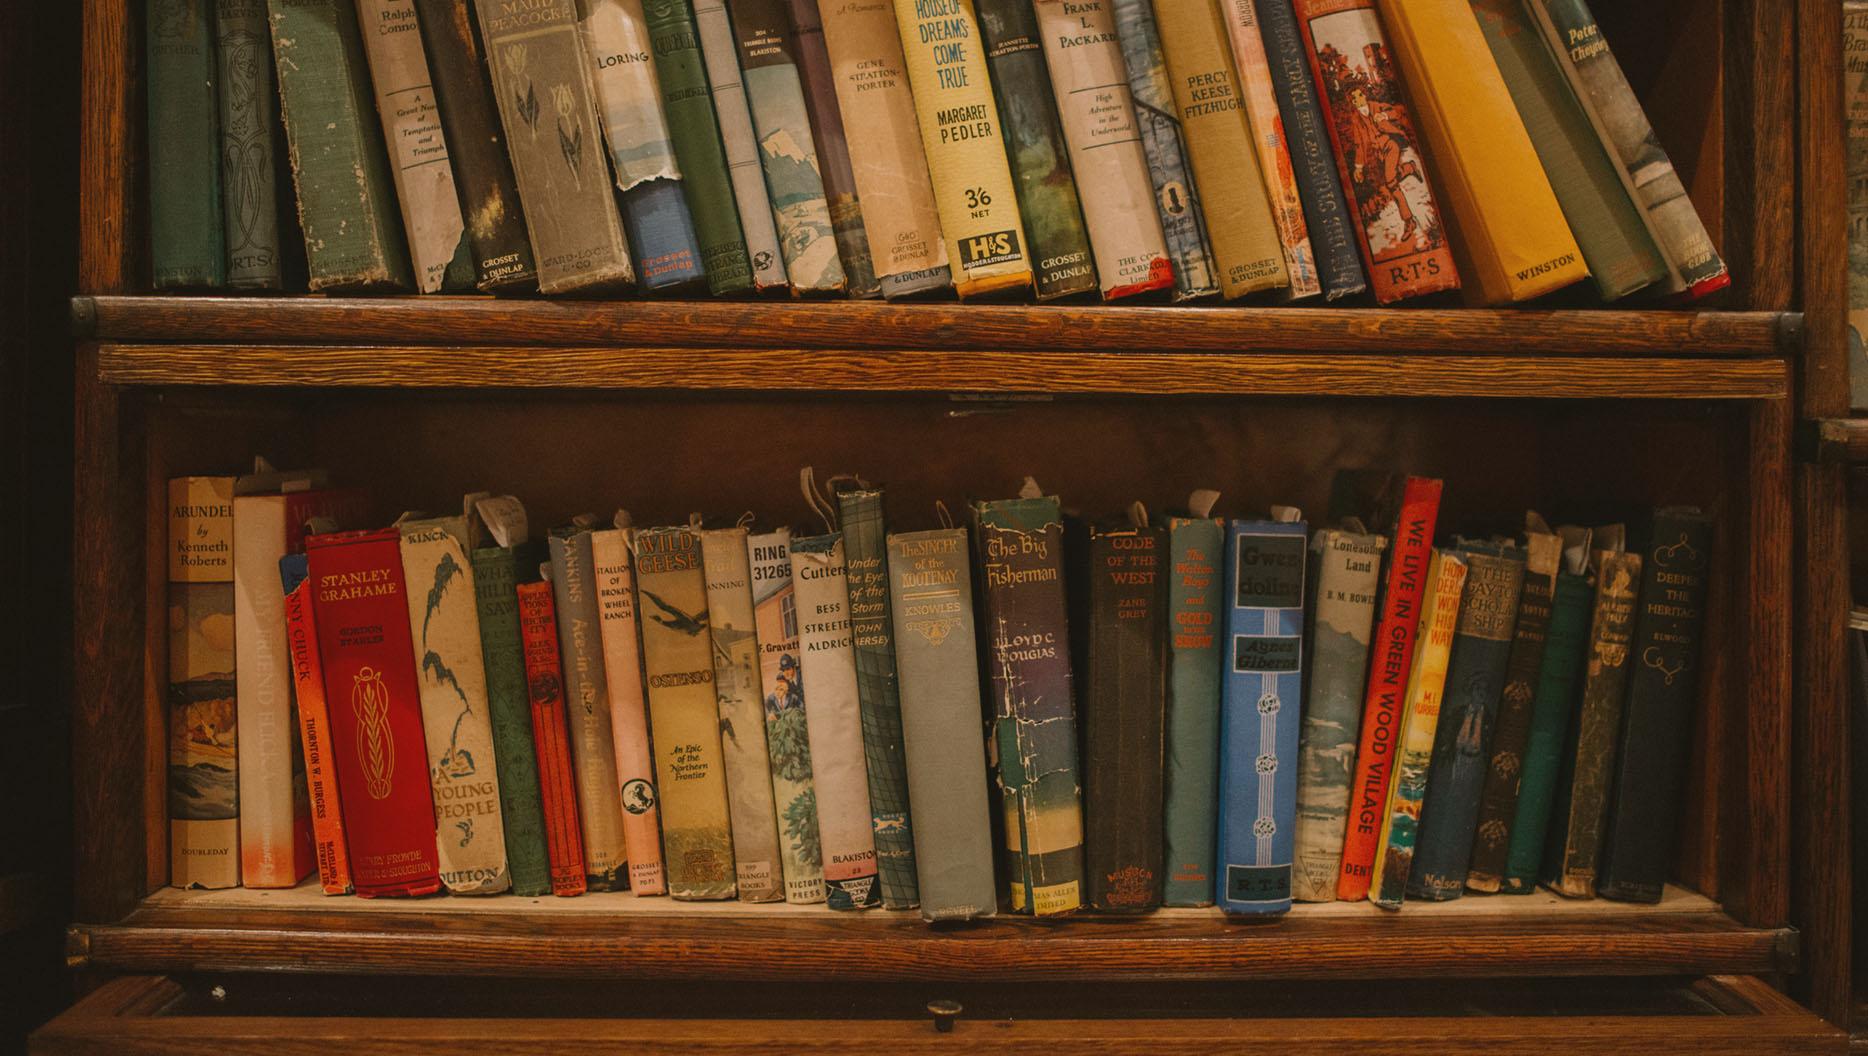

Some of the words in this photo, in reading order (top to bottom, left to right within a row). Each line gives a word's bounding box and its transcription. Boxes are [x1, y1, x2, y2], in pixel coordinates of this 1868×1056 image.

[382, 9, 415, 21] Ralph
[502, 0, 553, 15] MAUD
[916, 0, 949, 20] HOUSE
[1063, 0, 1102, 15] FRANK
[1080, 16, 1095, 29] L.
[919, 18, 969, 45] DREAMS
[1568, 24, 1599, 46] Peter
[1058, 32, 1117, 49] PACKARD
[933, 41, 968, 66] COME
[1570, 41, 1610, 62] Cheyney
[597, 51, 649, 70] LORING
[856, 60, 885, 70] GENE
[849, 69, 901, 83] STRATTON-
[936, 65, 970, 90] TRUE
[1187, 70, 1229, 89] PERCY
[856, 79, 898, 93] PORTER
[1095, 93, 1113, 105] High
[1191, 85, 1232, 103] KEESE
[396, 106, 418, 118] Great
[935, 103, 988, 128] MARGARET
[1089, 104, 1123, 117] Adventure
[1184, 98, 1246, 120] FITZHUGH
[416, 114, 425, 122] of
[418, 135, 433, 145] and
[941, 121, 993, 144] PEDLER
[412, 146, 445, 158] Triumph
[971, 208, 991, 220] NET
[482, 253, 520, 269] GROSSET
[1041, 252, 1088, 270] GROSSET
[1117, 256, 1139, 268] THE
[1228, 258, 1277, 275] GROSSET
[1516, 253, 1576, 281] WINSTON
[489, 264, 524, 280] DUNLAP
[903, 269, 942, 282] DUNLAP
[1050, 264, 1091, 282] DUNLAP
[1239, 265, 1281, 282] DUNLAP
[173, 505, 235, 519] ARUNDEL
[196, 527, 209, 537] by
[1406, 519, 1425, 547] WE
[177, 540, 229, 554] Kenneth
[640, 533, 693, 554] WILD
[901, 541, 920, 558] The
[919, 539, 959, 556] SINGER
[986, 536, 1018, 560] The
[1019, 535, 1048, 561] Big
[1112, 537, 1155, 550] CODE
[180, 554, 227, 567] Roberts
[753, 544, 786, 562] RING
[638, 552, 698, 575] GEESE
[847, 556, 882, 569] Under
[914, 560, 926, 572] of
[928, 558, 945, 570] the
[1106, 555, 1125, 567] OF
[1130, 555, 1157, 567] THE
[1344, 558, 1372, 573] Land
[320, 568, 392, 589] STANLEY
[754, 563, 792, 582] 31265
[800, 565, 850, 581] Cutters
[901, 570, 959, 588] KOOTENAY
[986, 563, 1057, 588] Fisherman
[1110, 571, 1156, 585] WEST
[1399, 553, 1421, 593] LIVE
[1482, 566, 1512, 581] THE
[1656, 571, 1698, 586] DEEPER
[610, 577, 620, 586] OF
[864, 573, 885, 588] Eye
[319, 582, 397, 603] GRAHAME
[601, 587, 631, 598] BROKEN
[850, 587, 862, 602] of
[865, 586, 886, 599] the
[604, 599, 630, 609] WHEEL
[816, 602, 841, 615] BESS
[850, 602, 885, 614] Storm
[903, 602, 961, 617] KNOWLES
[1118, 598, 1147, 608] ZANE
[1394, 598, 1413, 620] IN
[1437, 596, 1458, 610] WON
[604, 610, 632, 620] RANCH
[1118, 610, 1147, 620] GREY
[1435, 613, 1455, 629] HIS
[1473, 613, 1505, 631] SHIP
[853, 622, 883, 635] JOHN
[766, 640, 801, 653] Gravatt
[293, 628, 311, 682] CHUCK
[1384, 626, 1408, 686] GREEN
[650, 669, 712, 689] OSTENSO
[1371, 690, 1397, 755] WOOD
[670, 744, 683, 755] An
[684, 743, 703, 756] Epic
[676, 754, 688, 766] of
[688, 753, 701, 763] the
[305, 717, 320, 765] THORNTON
[313, 780, 328, 820] BURGESS
[670, 762, 709, 775] Northern
[674, 770, 707, 782] Frontier
[435, 768, 452, 786] A
[433, 781, 494, 802] YOUNG
[1357, 761, 1386, 835] VILLAGE
[436, 799, 497, 819] PEOPLE
[181, 847, 230, 857] DOUBLEDAY
[789, 877, 823, 890] VICTORY
[1423, 872, 1462, 889] Nelson
[793, 888, 823, 899] PRESS
